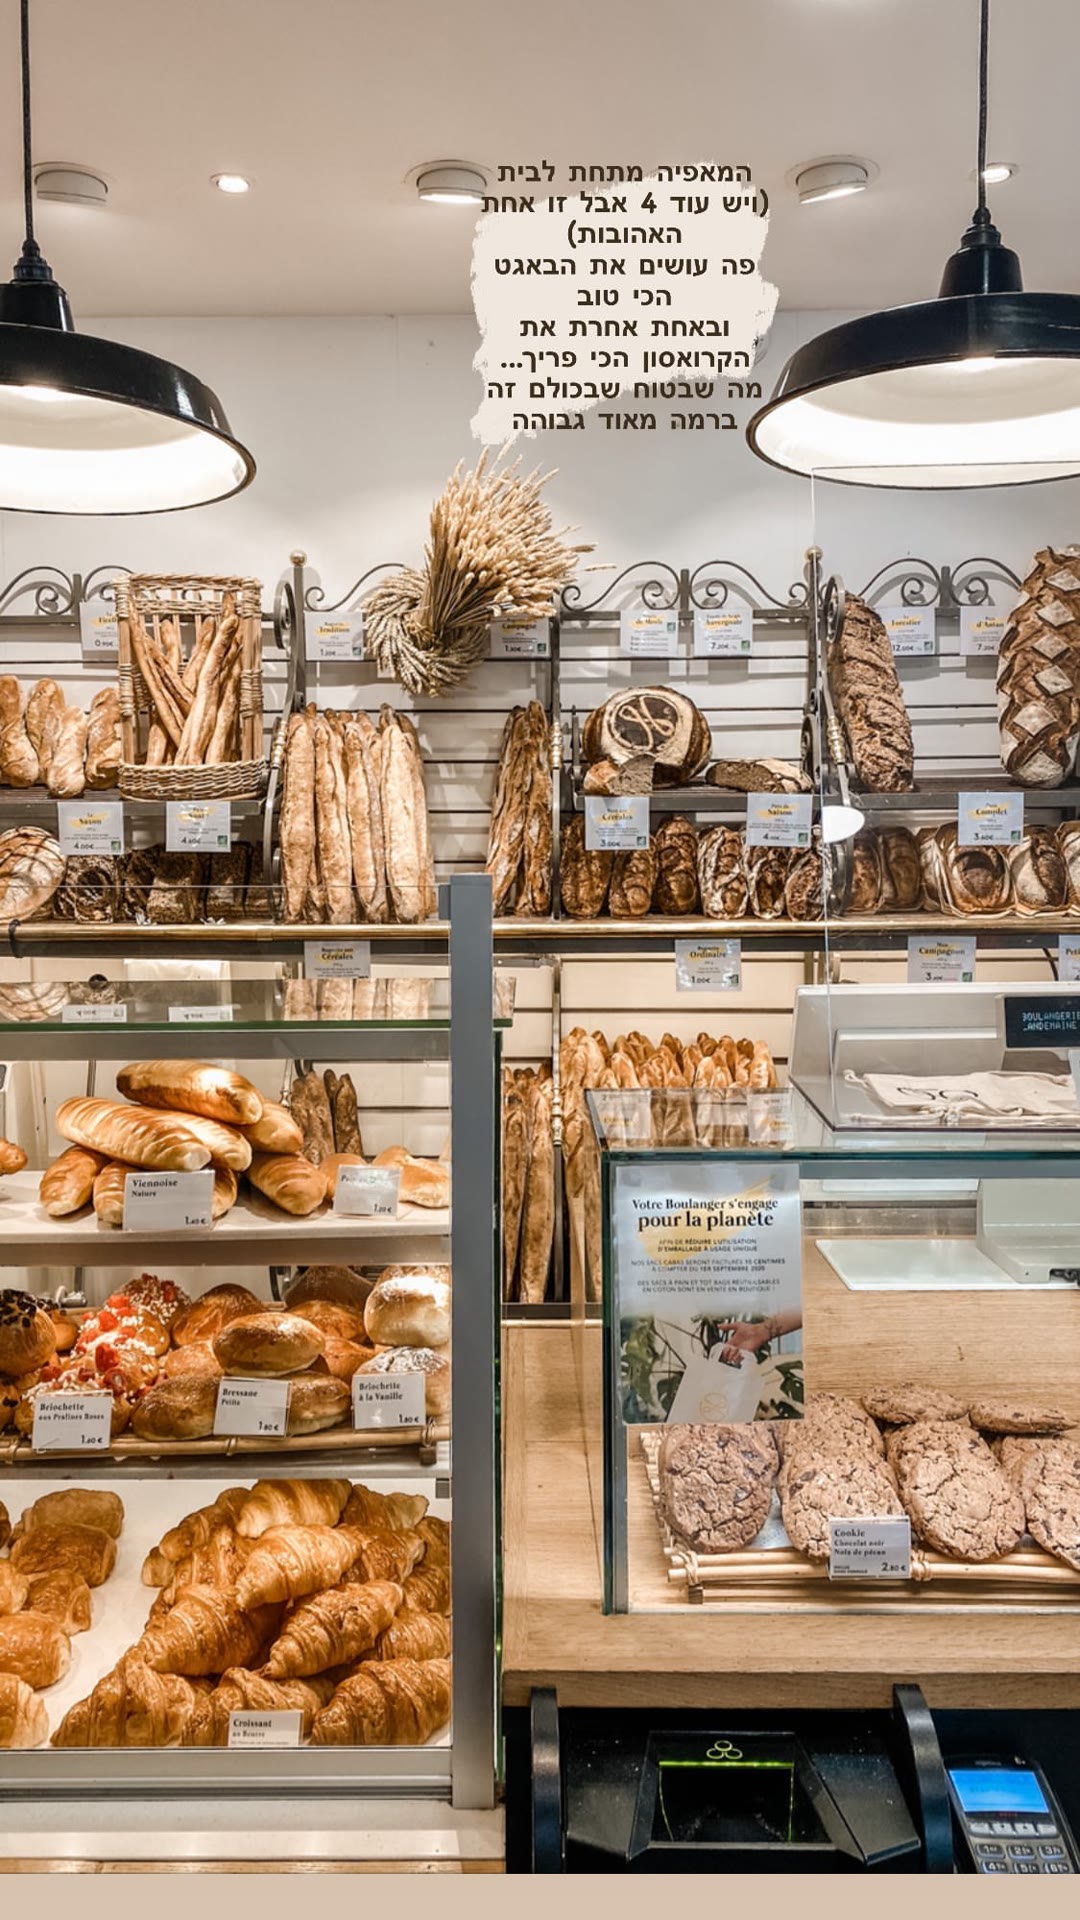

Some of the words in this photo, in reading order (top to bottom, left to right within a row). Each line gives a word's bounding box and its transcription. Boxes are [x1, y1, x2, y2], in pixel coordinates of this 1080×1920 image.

[1023, 1020, 1077, 1031] ANDEMAINE
[132, 1178, 178, 1188] Viennoise
[131, 1190, 157, 1198] Nature
[632, 1199, 663, 1210] Votre
[666, 1199, 726, 1211] Boulanger
[728, 1198, 779, 1211] s'engage
[638, 1215, 682, 1232] pour
[686, 1211, 701, 1227] la
[706, 1211, 774, 1231] planète
[359, 1381, 400, 1390] Briochette
[222, 1388, 258, 1397] Bressane
[375, 1391, 403, 1400] Vanille
[40, 1402, 85, 1411] Briochette
[53, 1412, 82, 1421] Pralines
[834, 1528, 865, 1537] Cookie
[834, 1539, 867, 1547] Chocolat
[233, 1719, 272, 1728] Croissant
